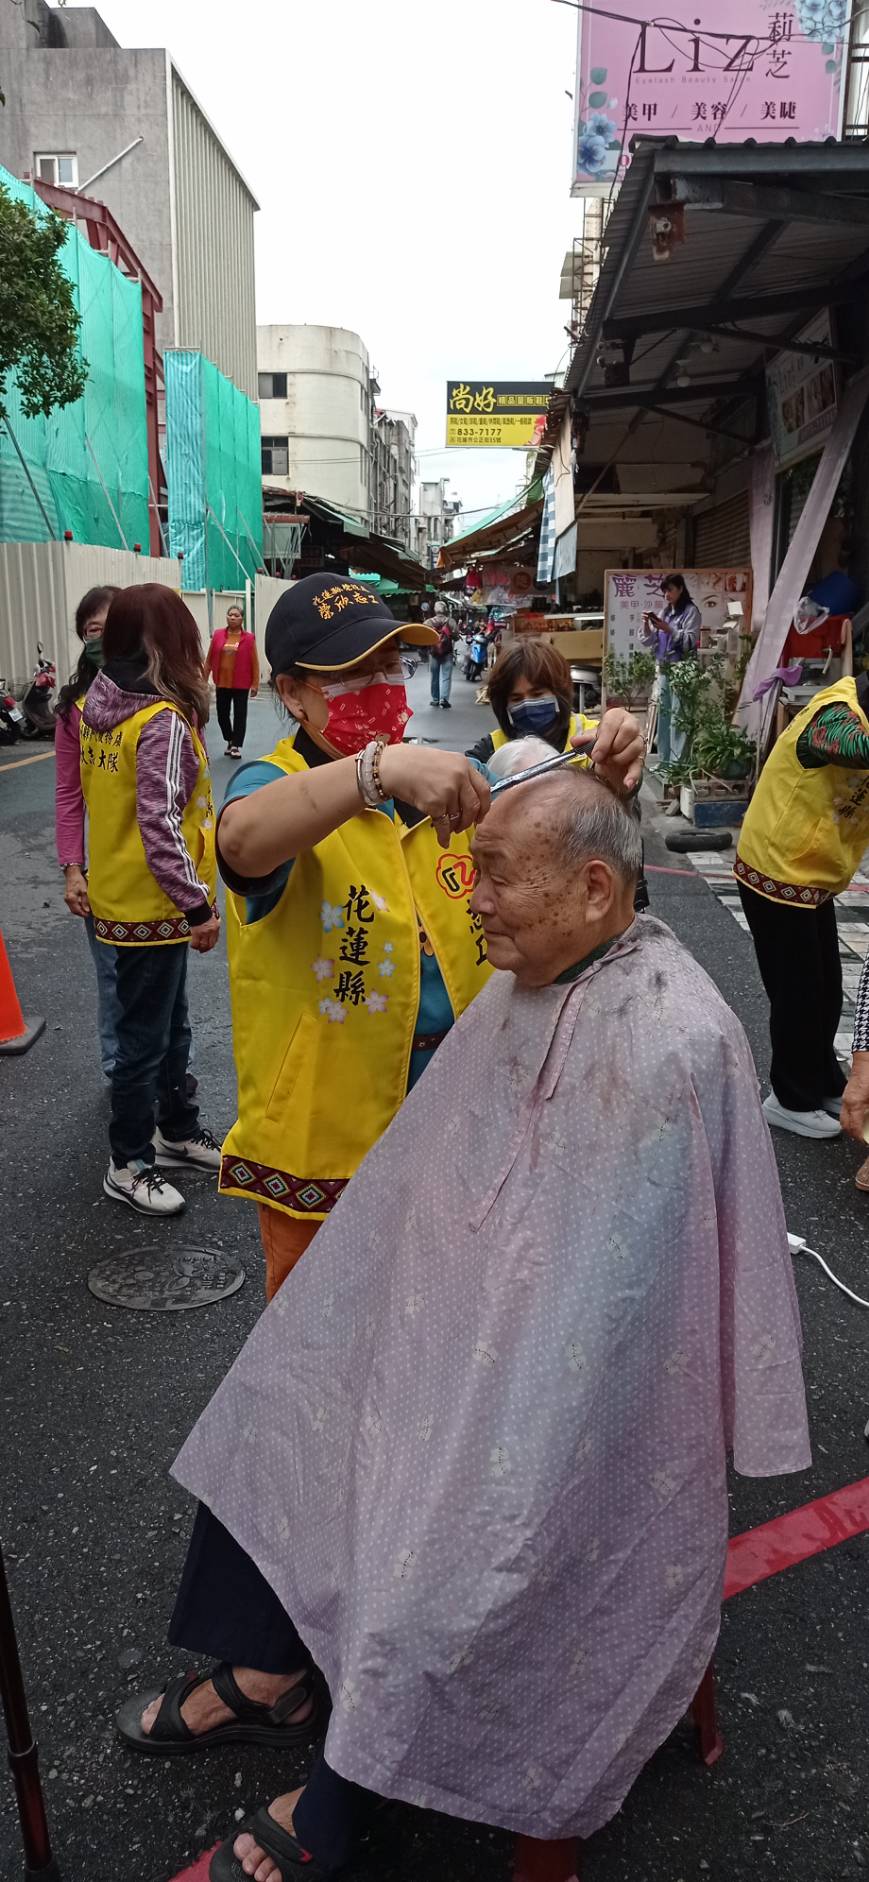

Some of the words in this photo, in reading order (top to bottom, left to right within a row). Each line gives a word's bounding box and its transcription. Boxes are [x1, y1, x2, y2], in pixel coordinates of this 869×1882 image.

[633, 19, 754, 73] Liz
[765, 12, 794, 79] 莉芝
[625, 102, 658, 122] 美甲
[691, 102, 728, 121] 美容
[761, 101, 796, 120] 美睫
[449, 383, 497, 413] 尚好
[457, 428, 502, 436] 833-7177
[612, 574, 665, 598] 麗芝
[333, 884, 375, 1006] 花蓮縣
